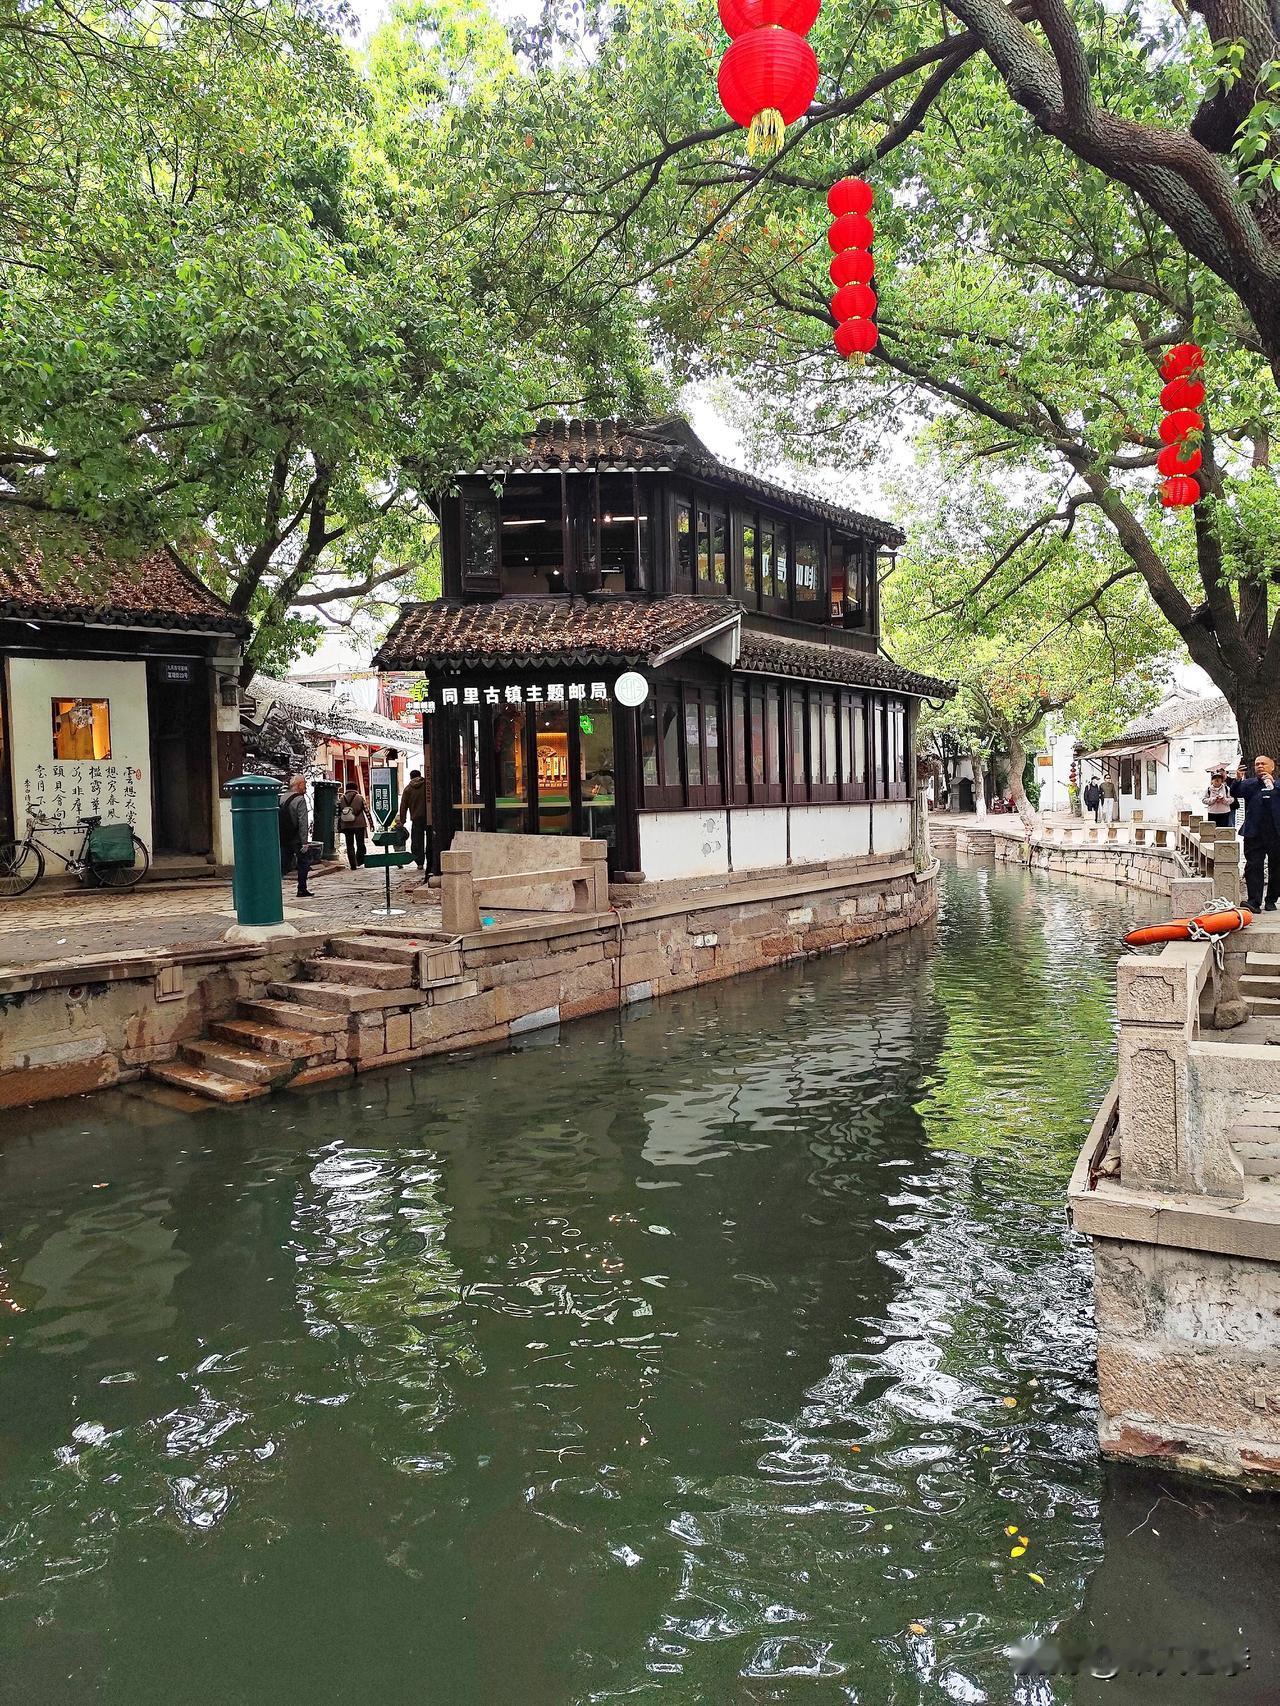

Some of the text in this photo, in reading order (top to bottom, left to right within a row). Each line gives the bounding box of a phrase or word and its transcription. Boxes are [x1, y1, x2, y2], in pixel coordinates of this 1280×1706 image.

[442, 682, 607, 705] 同里古镇主题邮局
